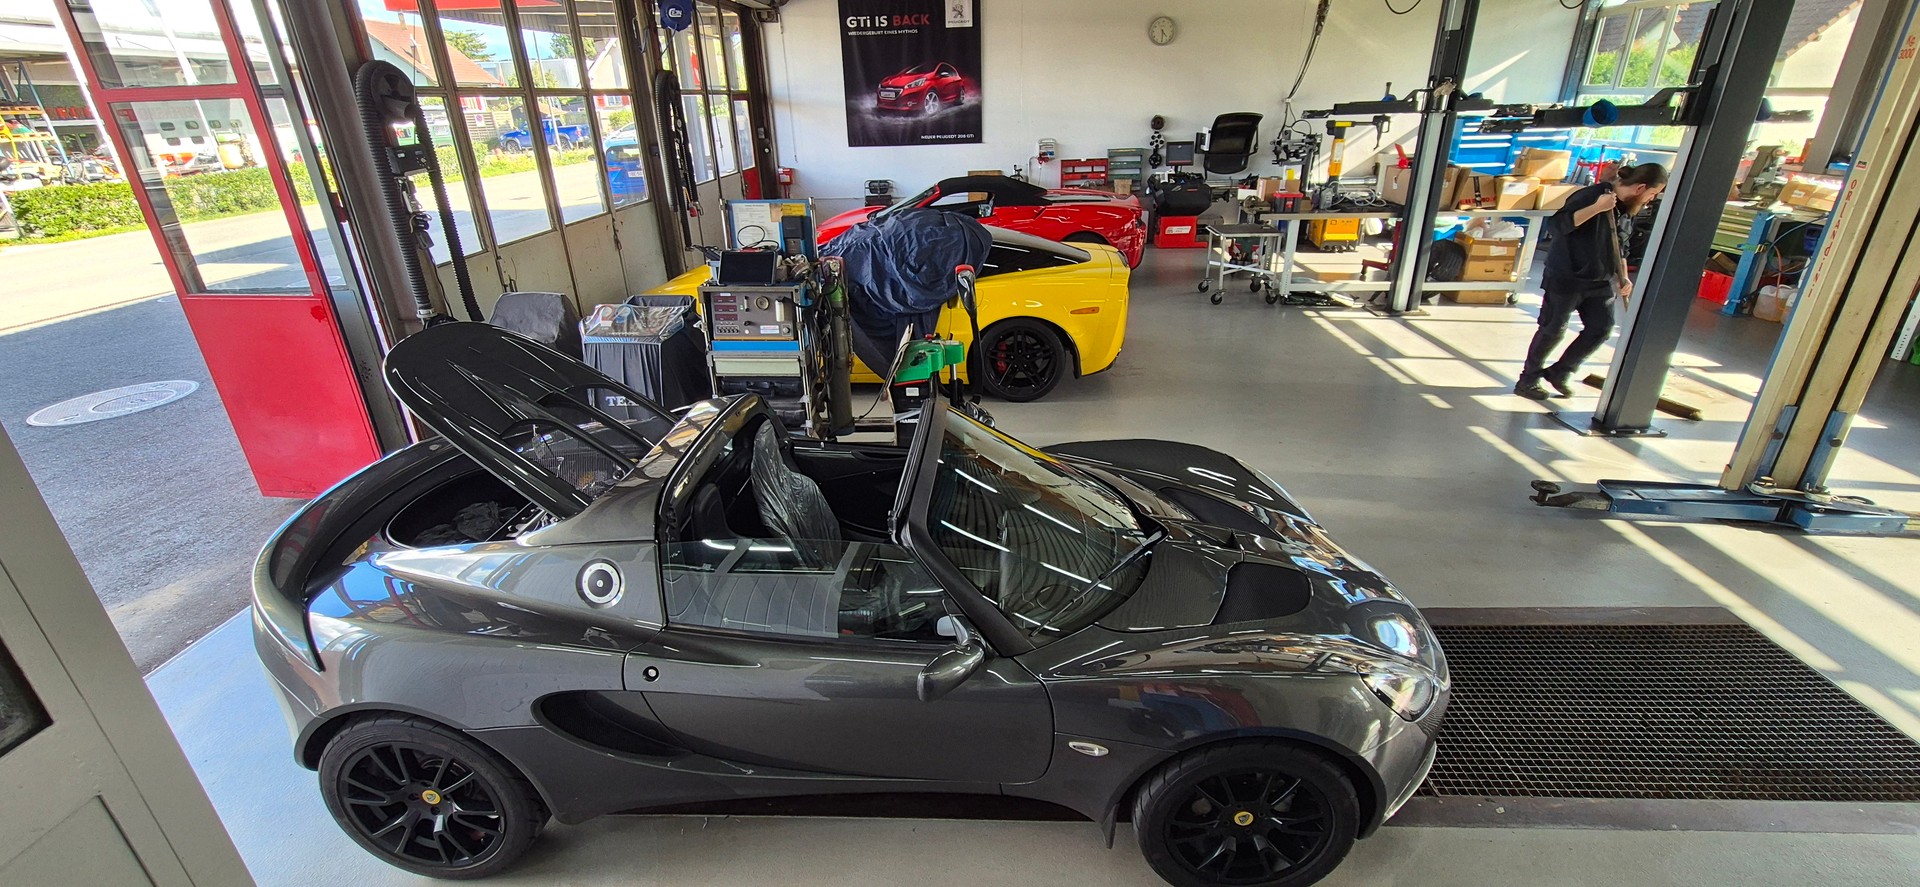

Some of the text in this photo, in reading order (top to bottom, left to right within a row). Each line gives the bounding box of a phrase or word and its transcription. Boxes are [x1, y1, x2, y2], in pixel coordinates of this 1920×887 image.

[846, 14, 930, 28] GTi IS BACK
